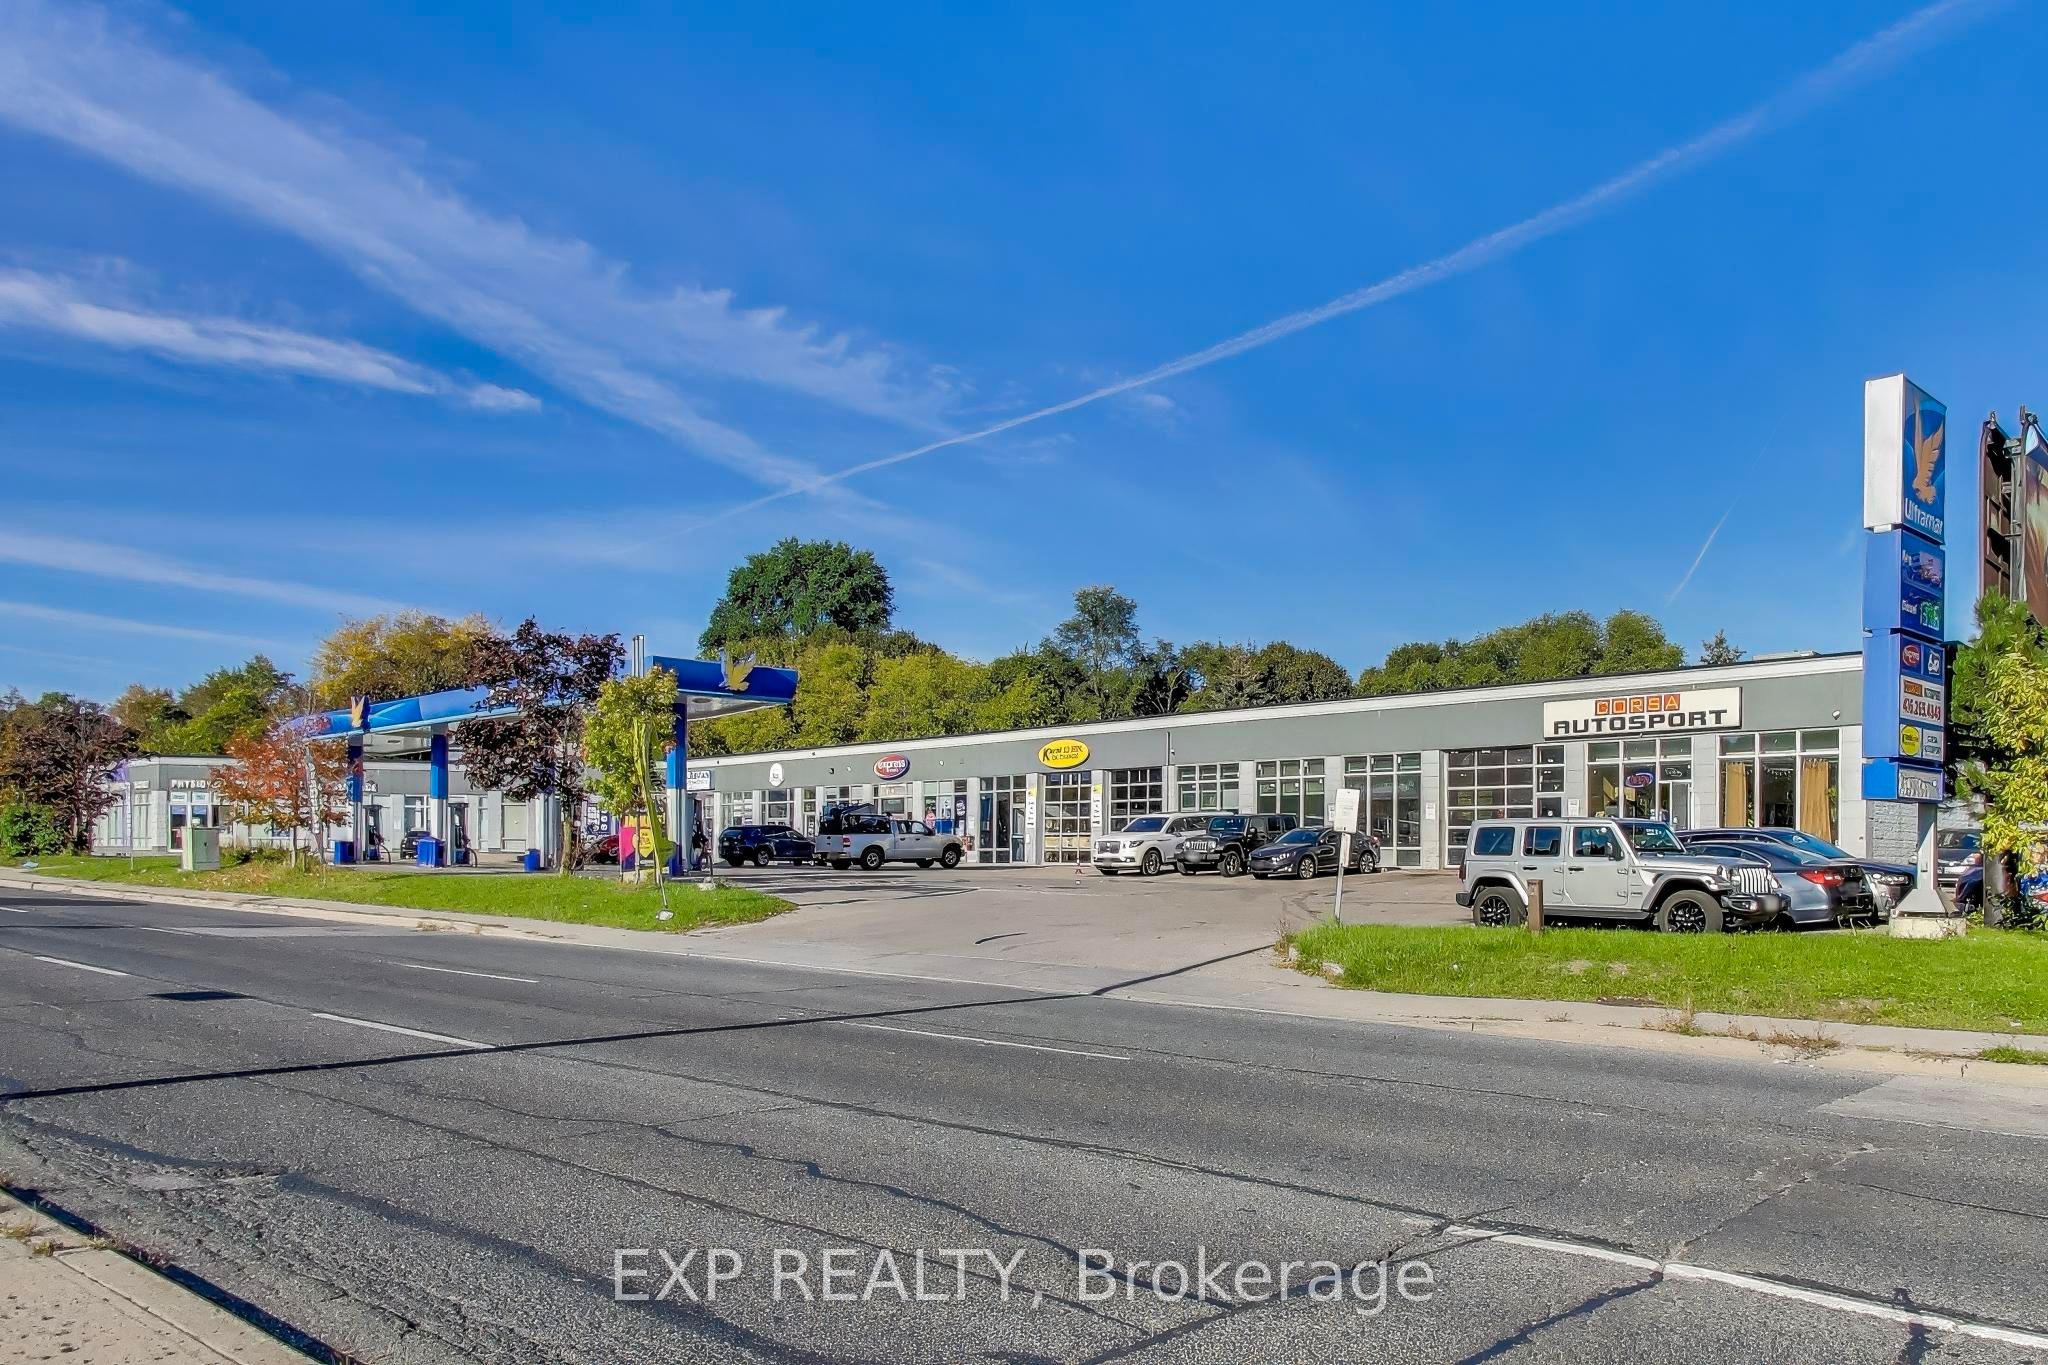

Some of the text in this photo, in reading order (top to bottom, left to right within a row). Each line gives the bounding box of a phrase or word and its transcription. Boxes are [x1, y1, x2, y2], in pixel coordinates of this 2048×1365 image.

[1905, 497, 1943, 535] Ultramar
[1595, 694, 1680, 716] CORSA
[1553, 709, 1728, 735] AUTOSPORT
